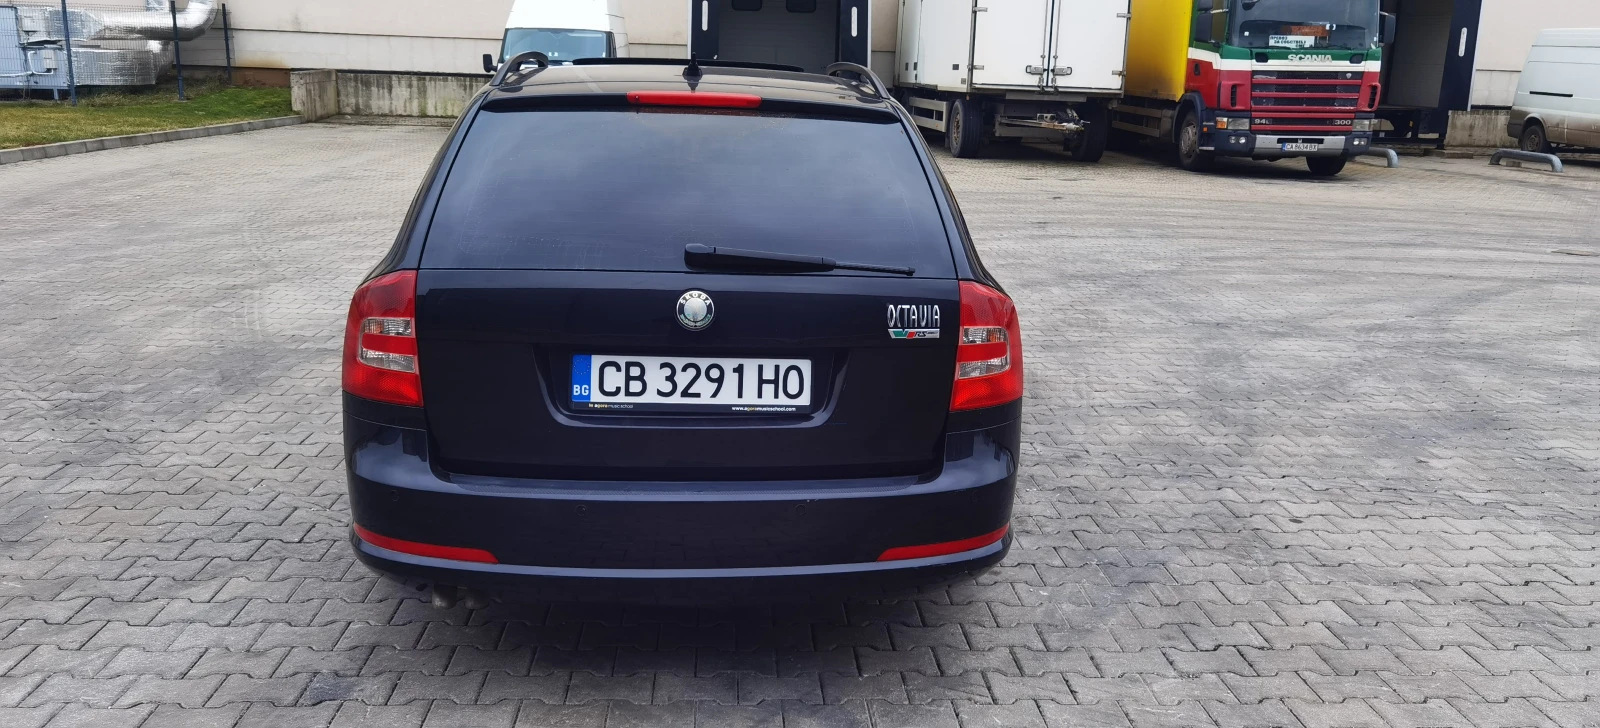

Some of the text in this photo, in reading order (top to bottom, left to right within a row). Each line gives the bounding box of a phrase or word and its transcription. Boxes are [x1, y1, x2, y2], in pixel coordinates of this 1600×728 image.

[1287, 53, 1333, 63] SCANIA
[887, 304, 940, 328] OCTAVIA
[598, 360, 647, 398] CB
[656, 361, 745, 399] 3291
[573, 384, 589, 396] BG
